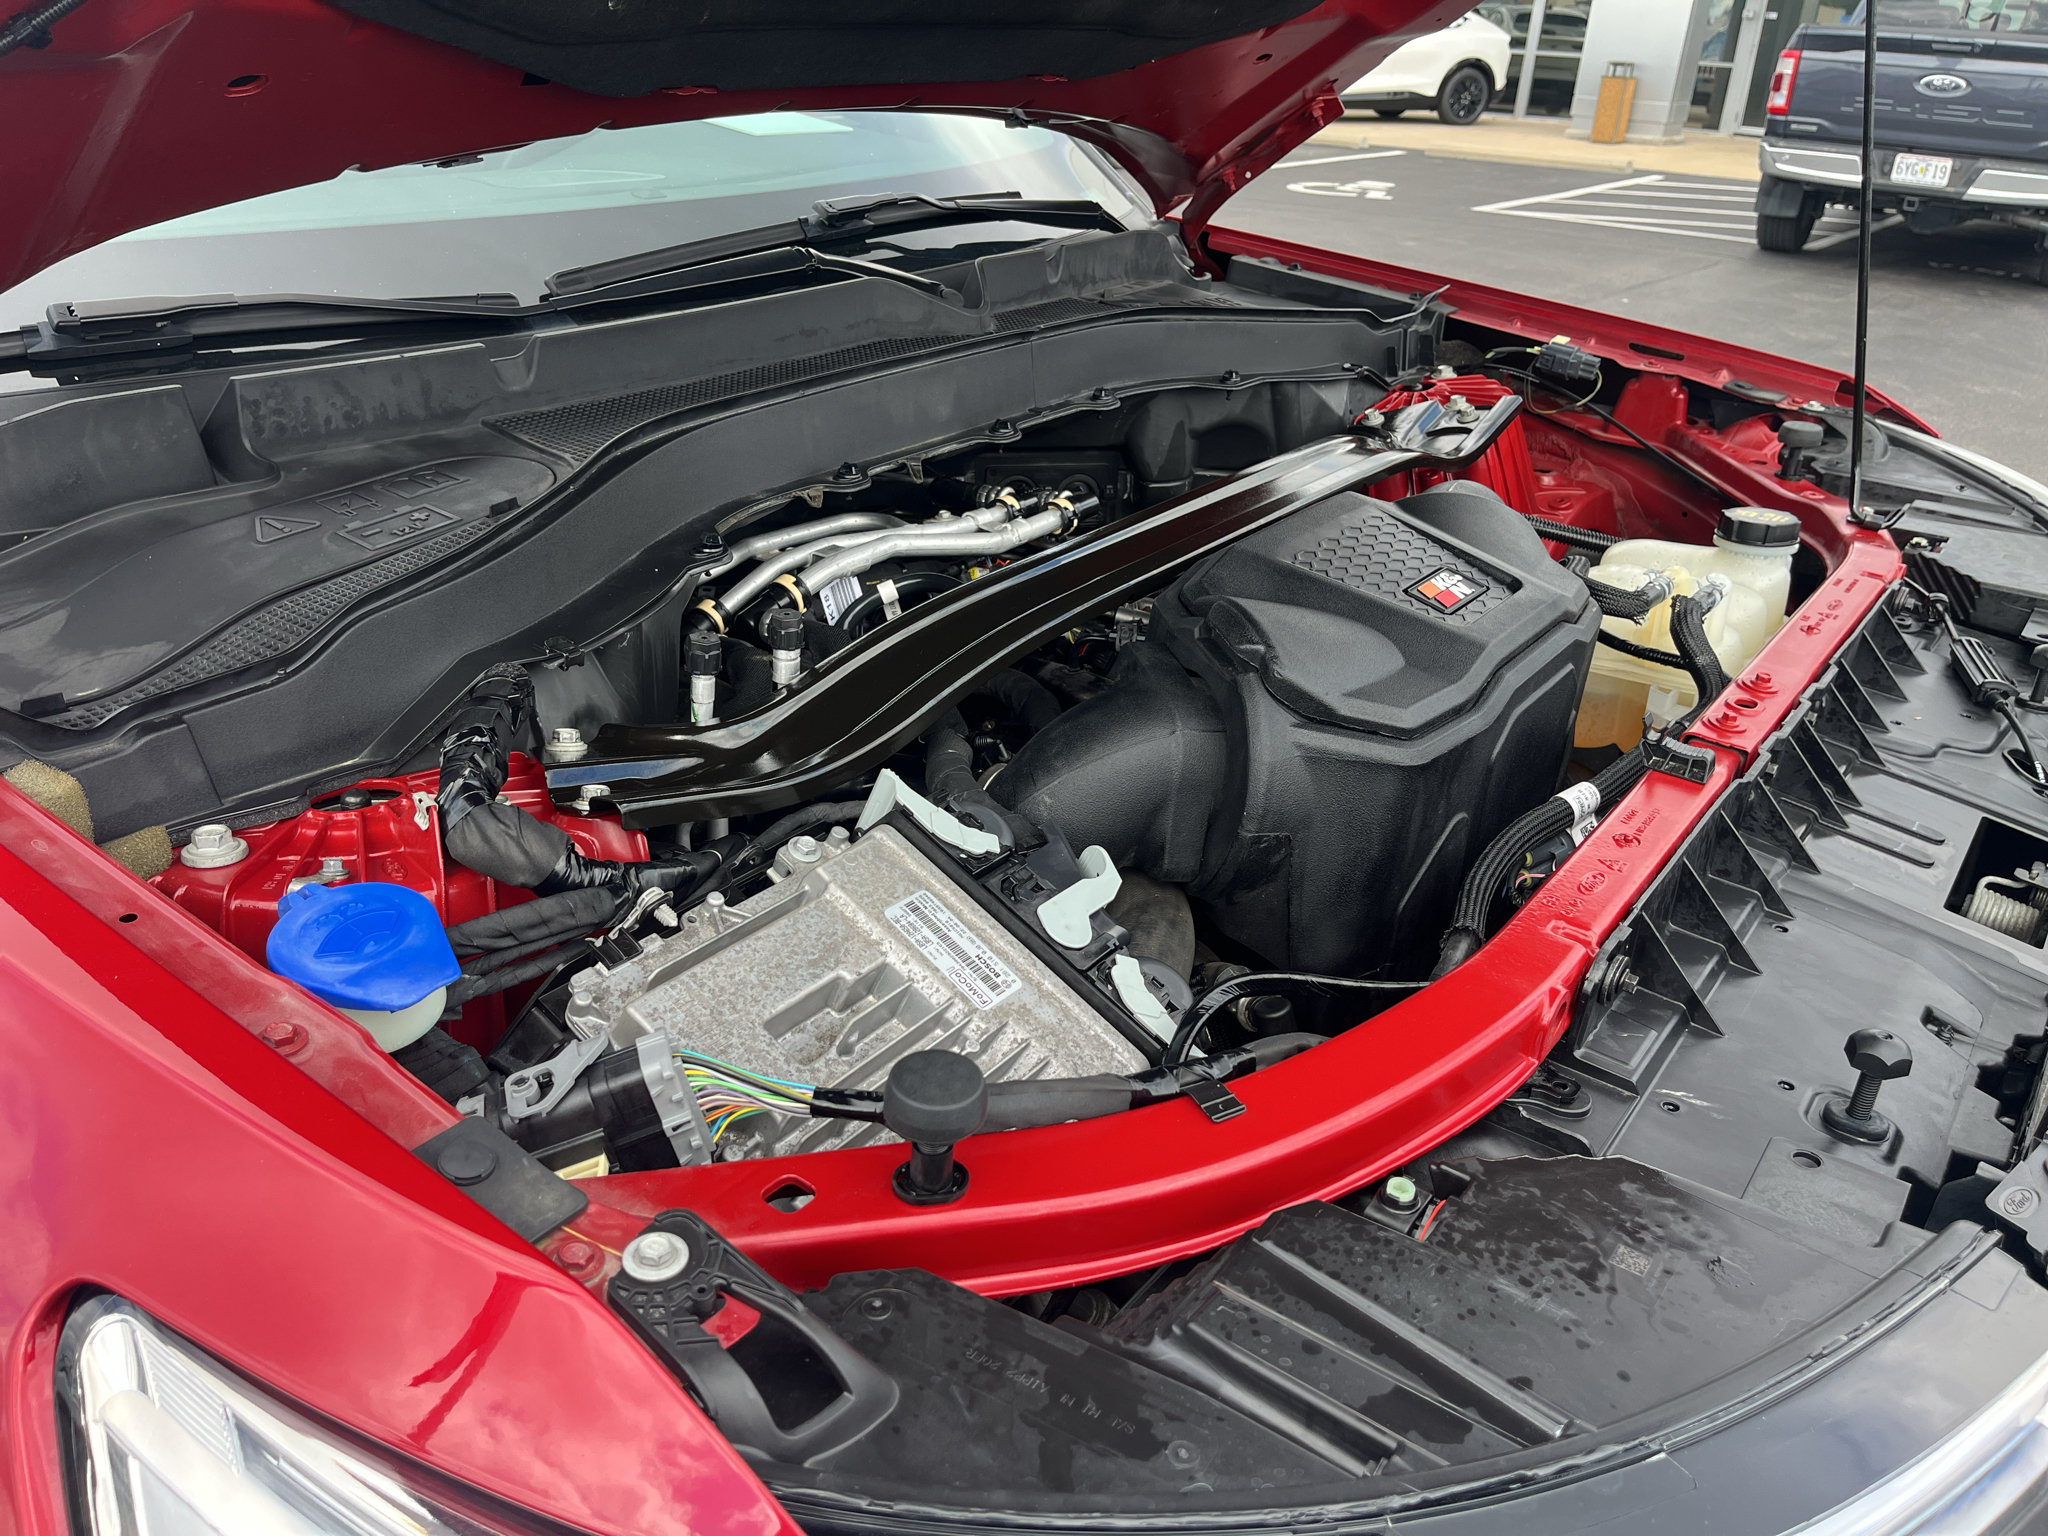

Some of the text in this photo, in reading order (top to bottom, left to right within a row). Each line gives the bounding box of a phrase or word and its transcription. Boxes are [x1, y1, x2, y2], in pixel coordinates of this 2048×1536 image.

[391, 520, 425, 537] 12V
[974, 953, 1001, 978] BOSCH
[952, 971, 988, 1005] FoMoCo
[2006, 1190, 2031, 1213] Ford
